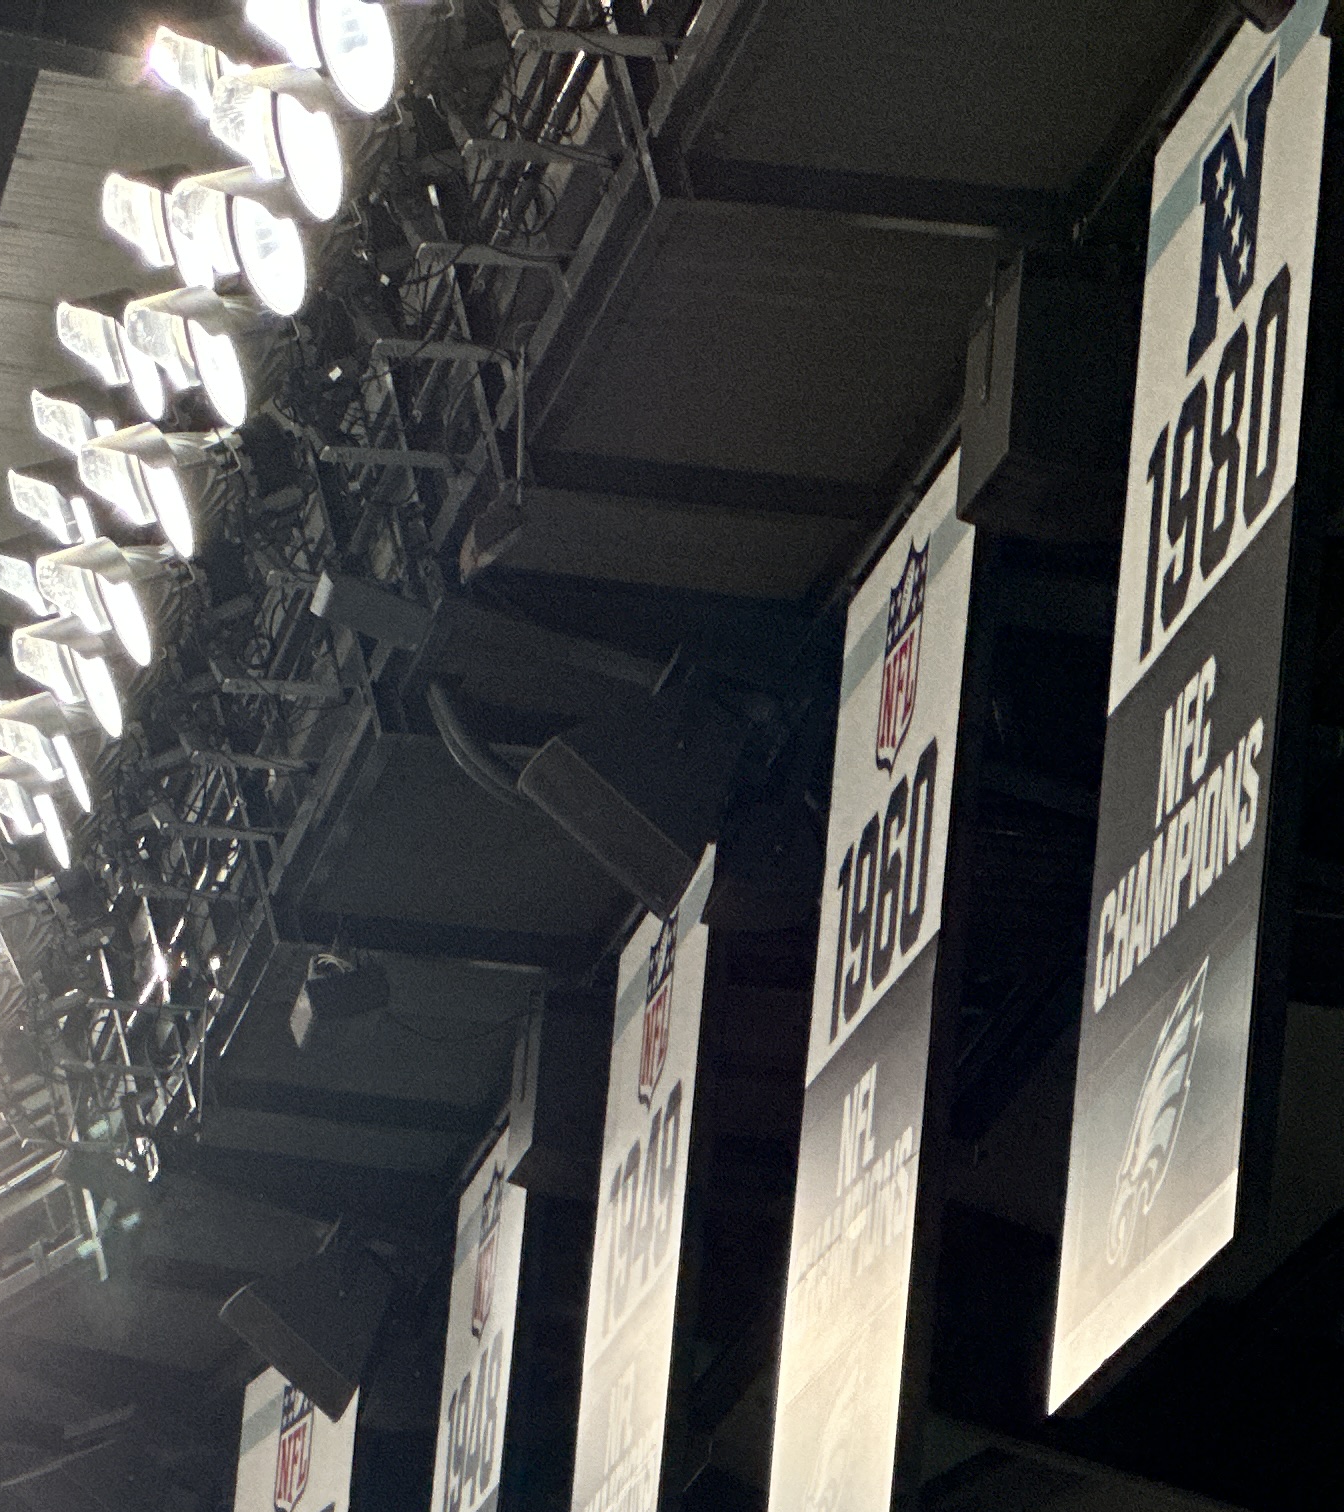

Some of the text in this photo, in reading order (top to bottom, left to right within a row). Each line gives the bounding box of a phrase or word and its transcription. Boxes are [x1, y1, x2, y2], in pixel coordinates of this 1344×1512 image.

[1138, 263, 1290, 662] 1980
[879, 628, 915, 750] NFL
[1155, 655, 1216, 829] NFC
[830, 738, 938, 1045] 1960
[1093, 716, 1264, 1014] CHAMPIONS
[603, 1078, 683, 1340] 1949
[836, 1061, 878, 1198] NFL
[277, 1422, 307, 1502] NFL
